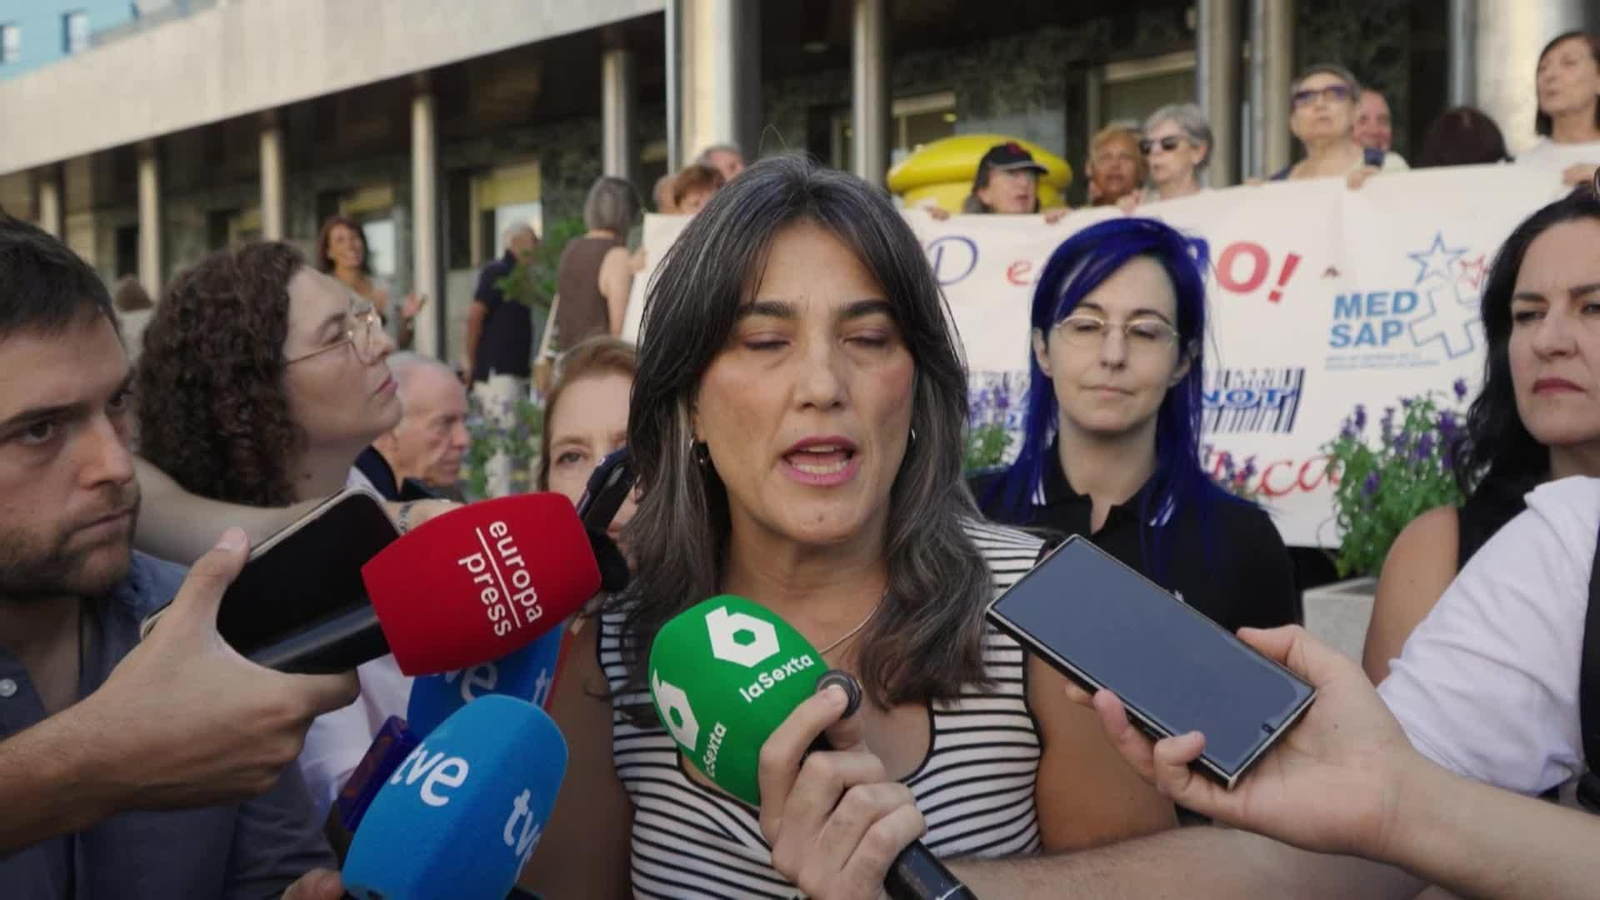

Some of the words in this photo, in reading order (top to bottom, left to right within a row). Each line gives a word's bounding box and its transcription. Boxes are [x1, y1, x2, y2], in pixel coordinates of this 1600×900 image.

[1333, 291, 1418, 318] MED
[1329, 320, 1403, 347] SAP
[457, 551, 513, 637] press
[489, 520, 543, 623] europa
[739, 653, 815, 703] laSexta
